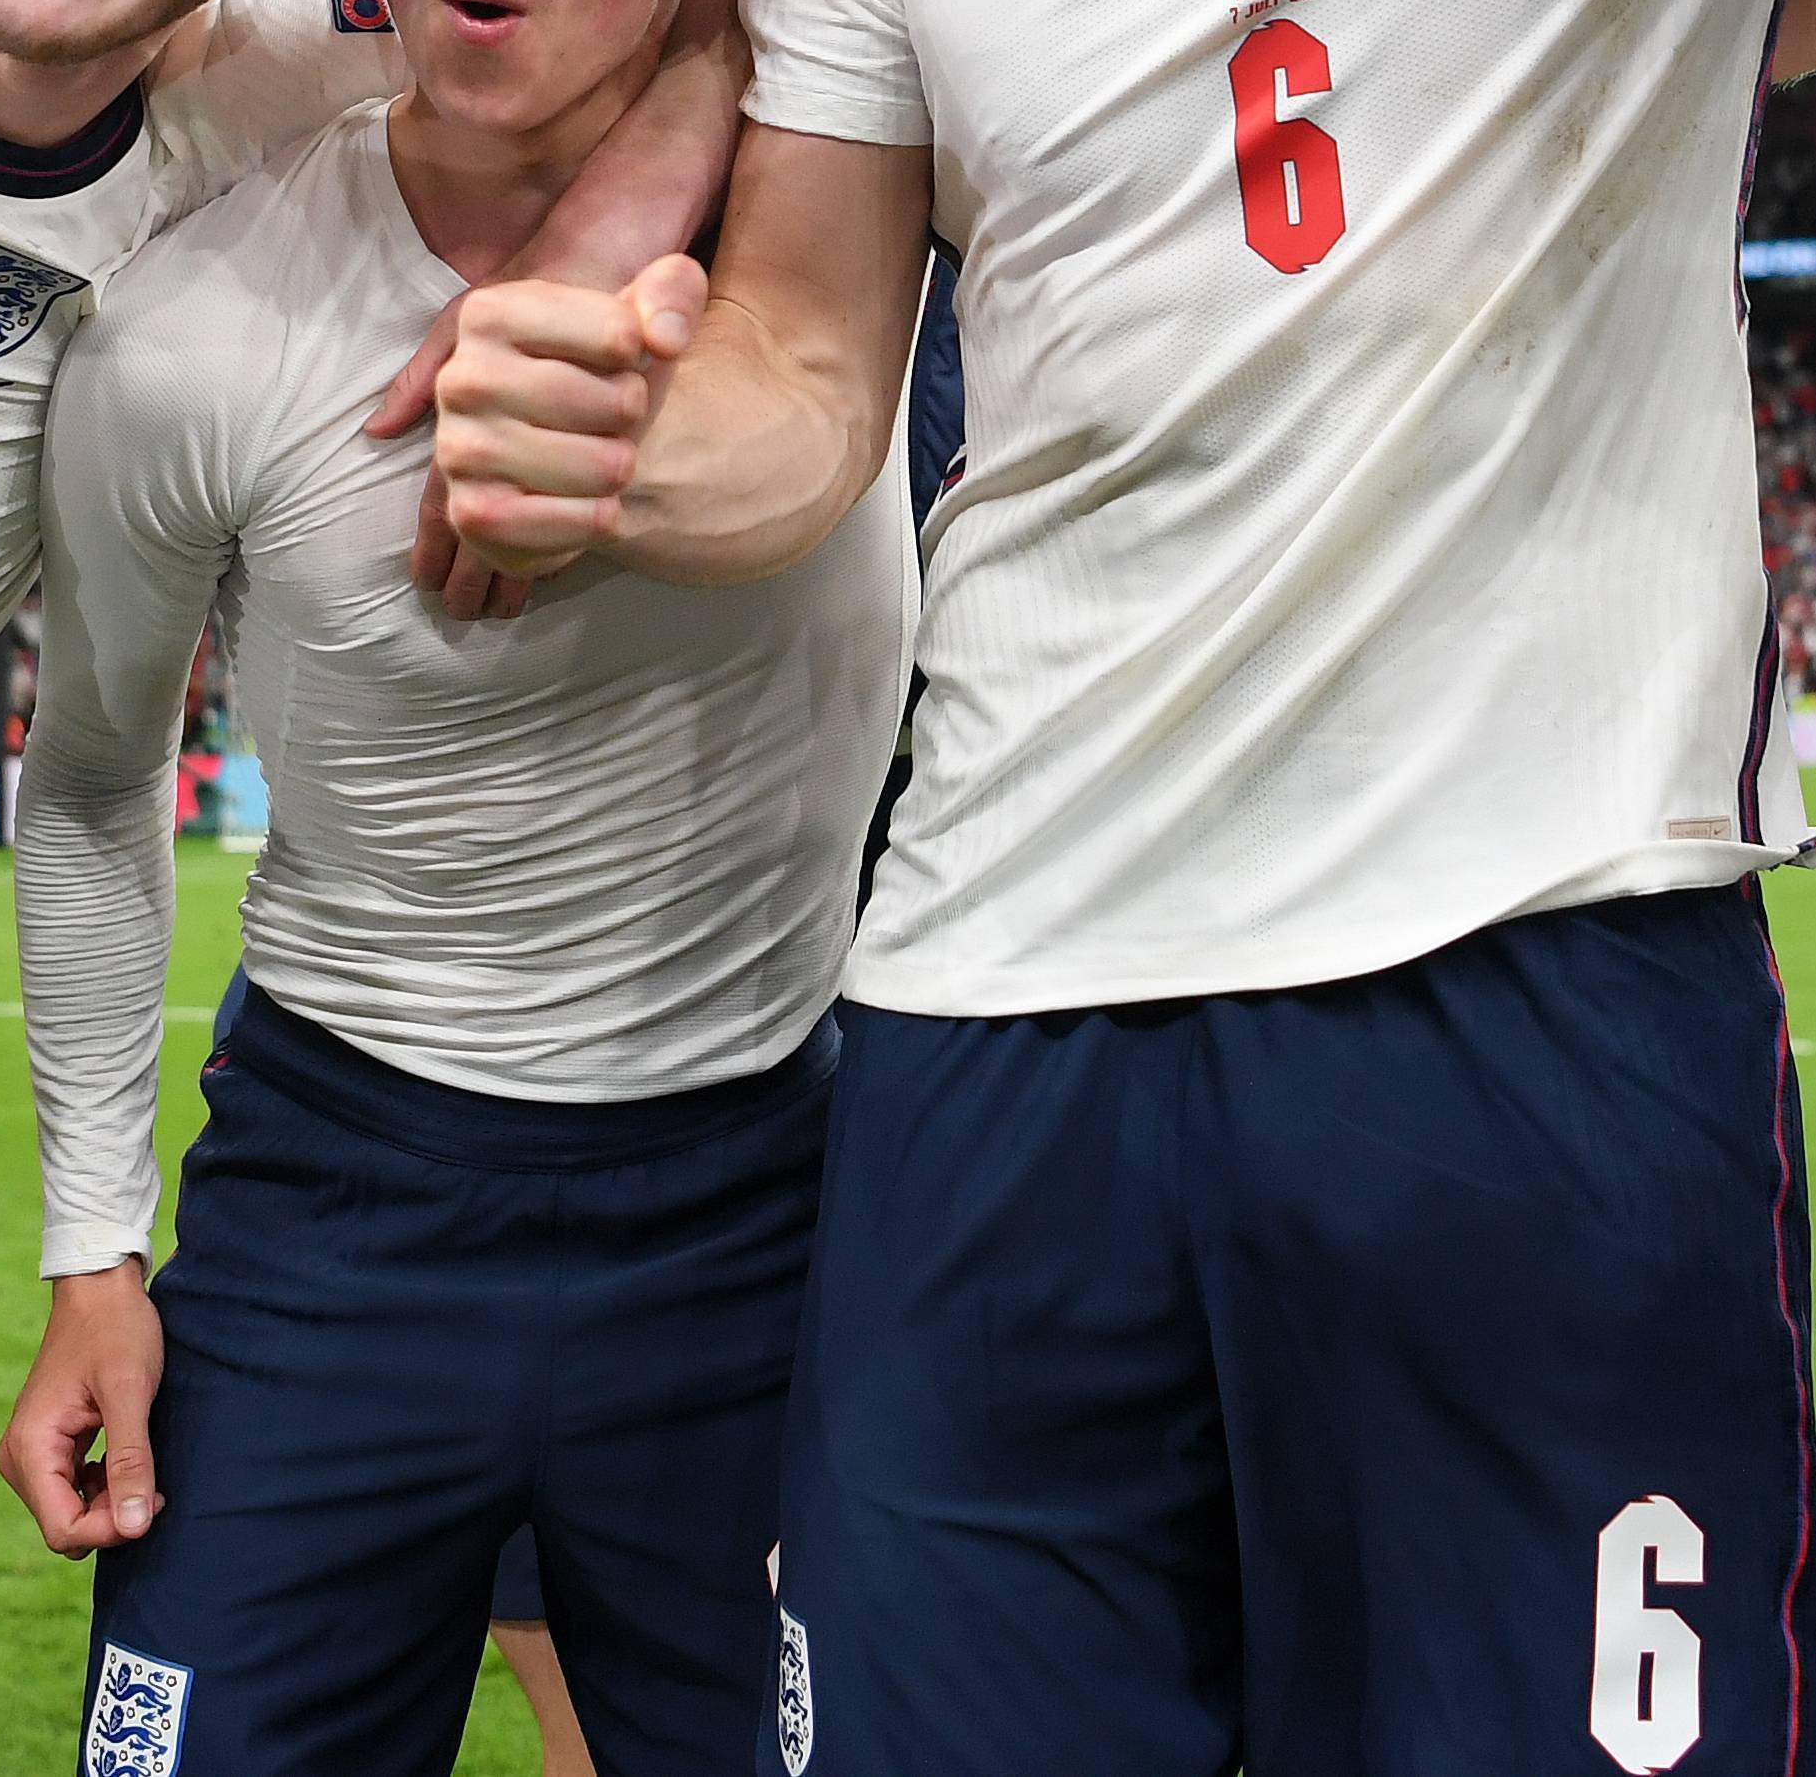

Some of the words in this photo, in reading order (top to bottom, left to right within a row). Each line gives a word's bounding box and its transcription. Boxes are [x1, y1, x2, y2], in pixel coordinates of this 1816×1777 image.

[1229, 7, 1239, 24] 7
[1227, 18, 1346, 274] 6
[1590, 1493, 1707, 1777] 6
